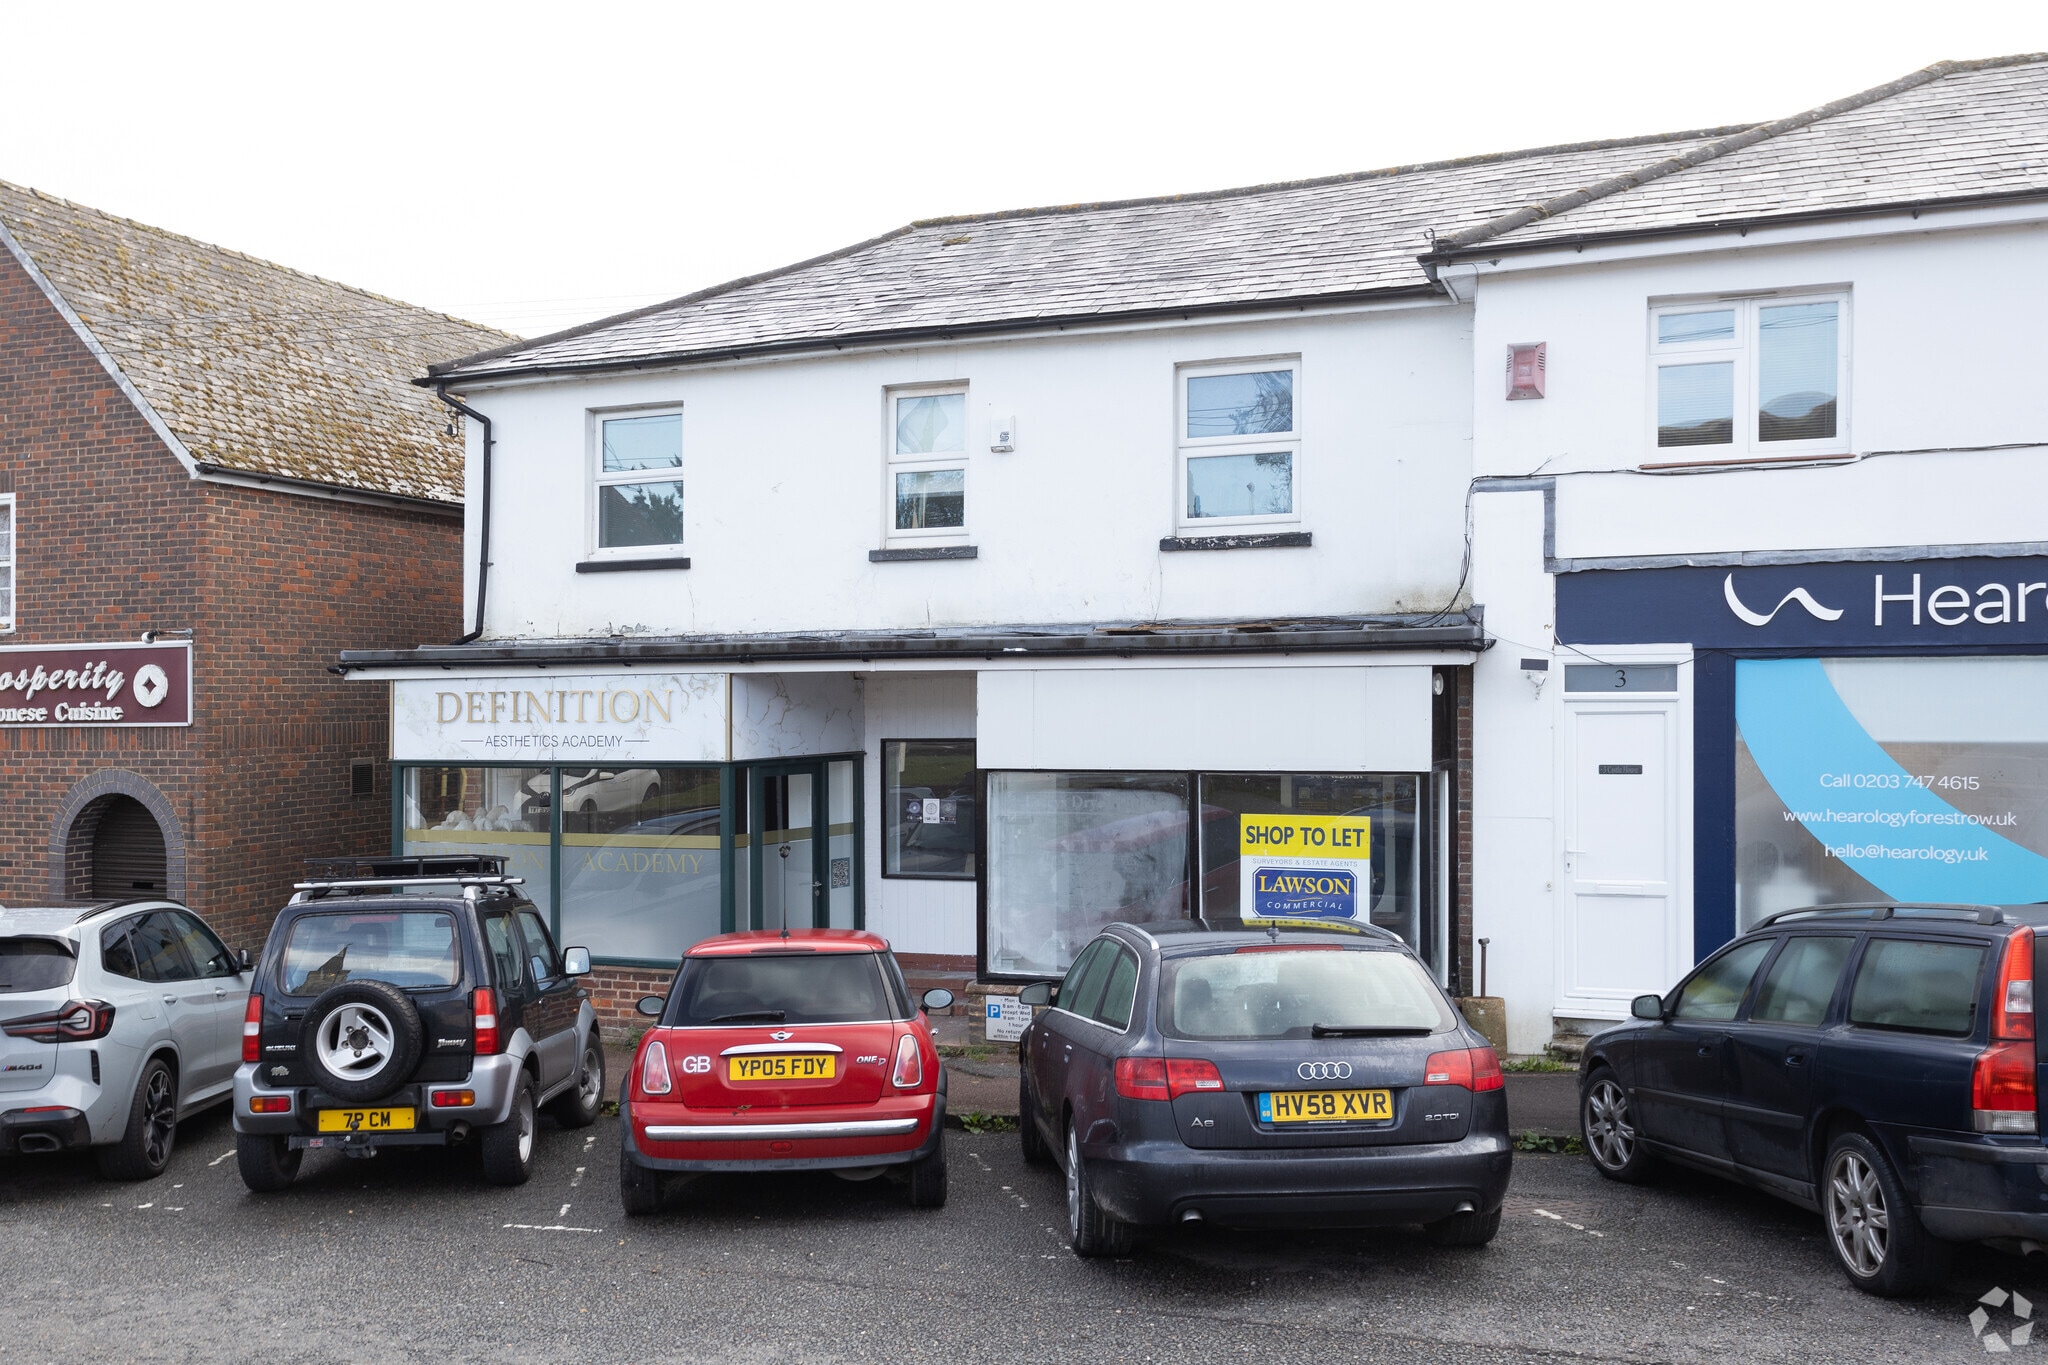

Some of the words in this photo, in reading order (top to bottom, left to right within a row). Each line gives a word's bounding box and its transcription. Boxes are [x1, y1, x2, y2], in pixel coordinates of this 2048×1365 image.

[1874, 573, 2048, 627] Hear
[1614, 669, 1627, 688] 3
[54, 701, 124, 722] Cuisine
[435, 689, 674, 725] DEFINITION
[485, 735, 559, 748] AESTHETICS
[562, 735, 623, 748] ACADEMY
[1819, 773, 1851, 788] Call
[1853, 774, 1900, 789] 0203
[1902, 775, 1935, 789] 747
[1937, 776, 1980, 790] 4615
[1783, 809, 2017, 828] www.hearologyforestrow.uk
[1245, 825, 1295, 845] SHOP
[1299, 827, 1326, 847] TO
[1331, 828, 1365, 848] LET
[580, 851, 704, 874] ACADEMY
[1252, 858, 1293, 866] SURVEYORS
[1302, 859, 1328, 867] ESTATE
[1330, 860, 1358, 868] AGENTS
[1824, 843, 1988, 864] hello@hearology.uk
[1258, 875, 1352, 896] LAWSON
[1266, 900, 1343, 910] COMMERCIAL
[682, 1056, 711, 1074] GB
[738, 1058, 786, 1077] YP05
[791, 1058, 827, 1075] FDY
[856, 1055, 878, 1065] ONE
[1275, 1094, 1336, 1117] HV58
[1342, 1093, 1387, 1115] XVR
[369, 1111, 391, 1128] CM
[1191, 1116, 1215, 1128] A6
